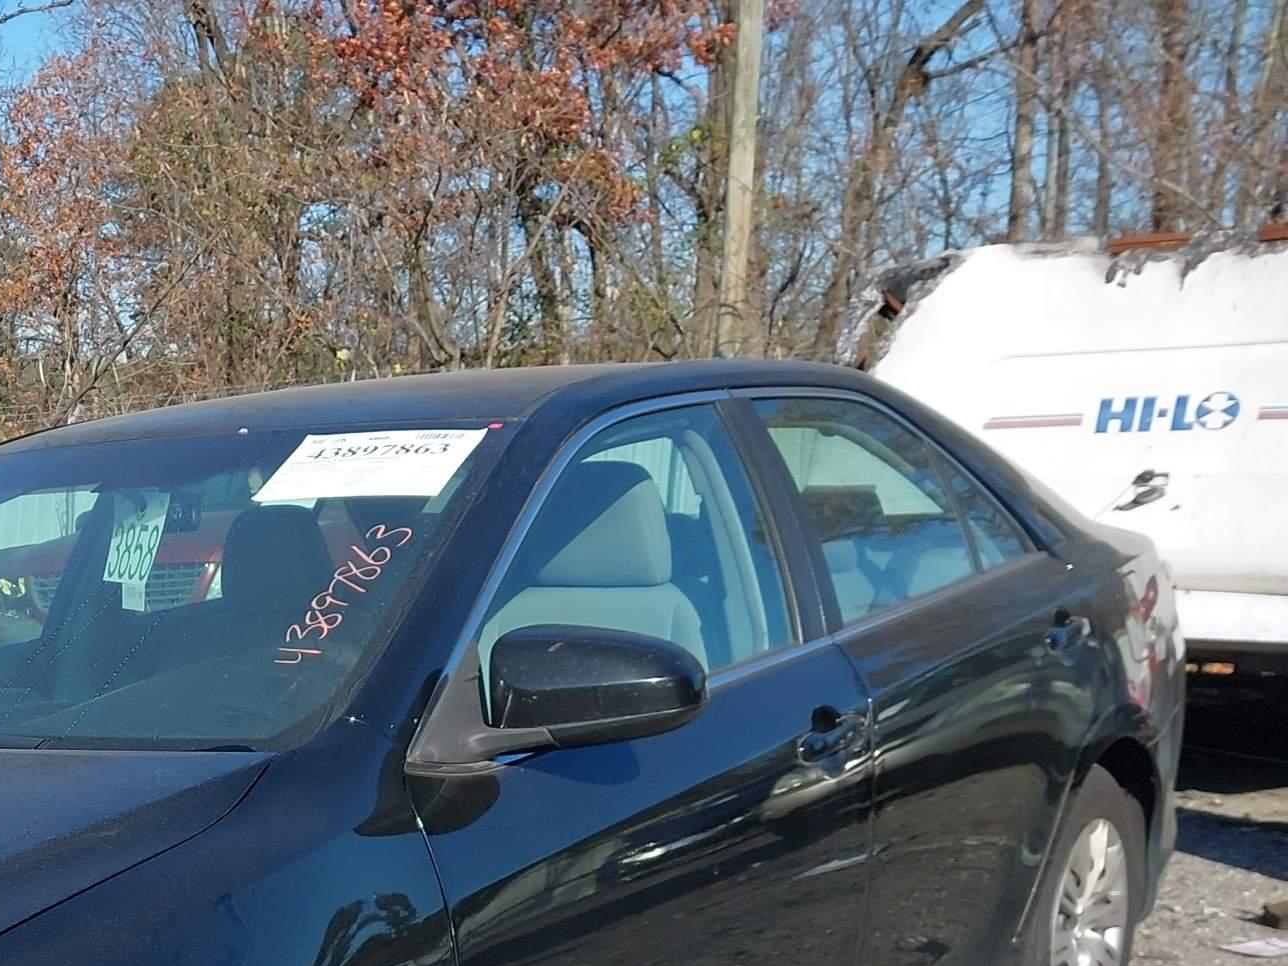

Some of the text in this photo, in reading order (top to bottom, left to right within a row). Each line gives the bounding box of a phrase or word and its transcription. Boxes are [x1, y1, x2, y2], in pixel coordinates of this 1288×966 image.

[307, 443, 451, 461] 43897863
[107, 522, 159, 581] 3858
[273, 524, 413, 664] 43897863
